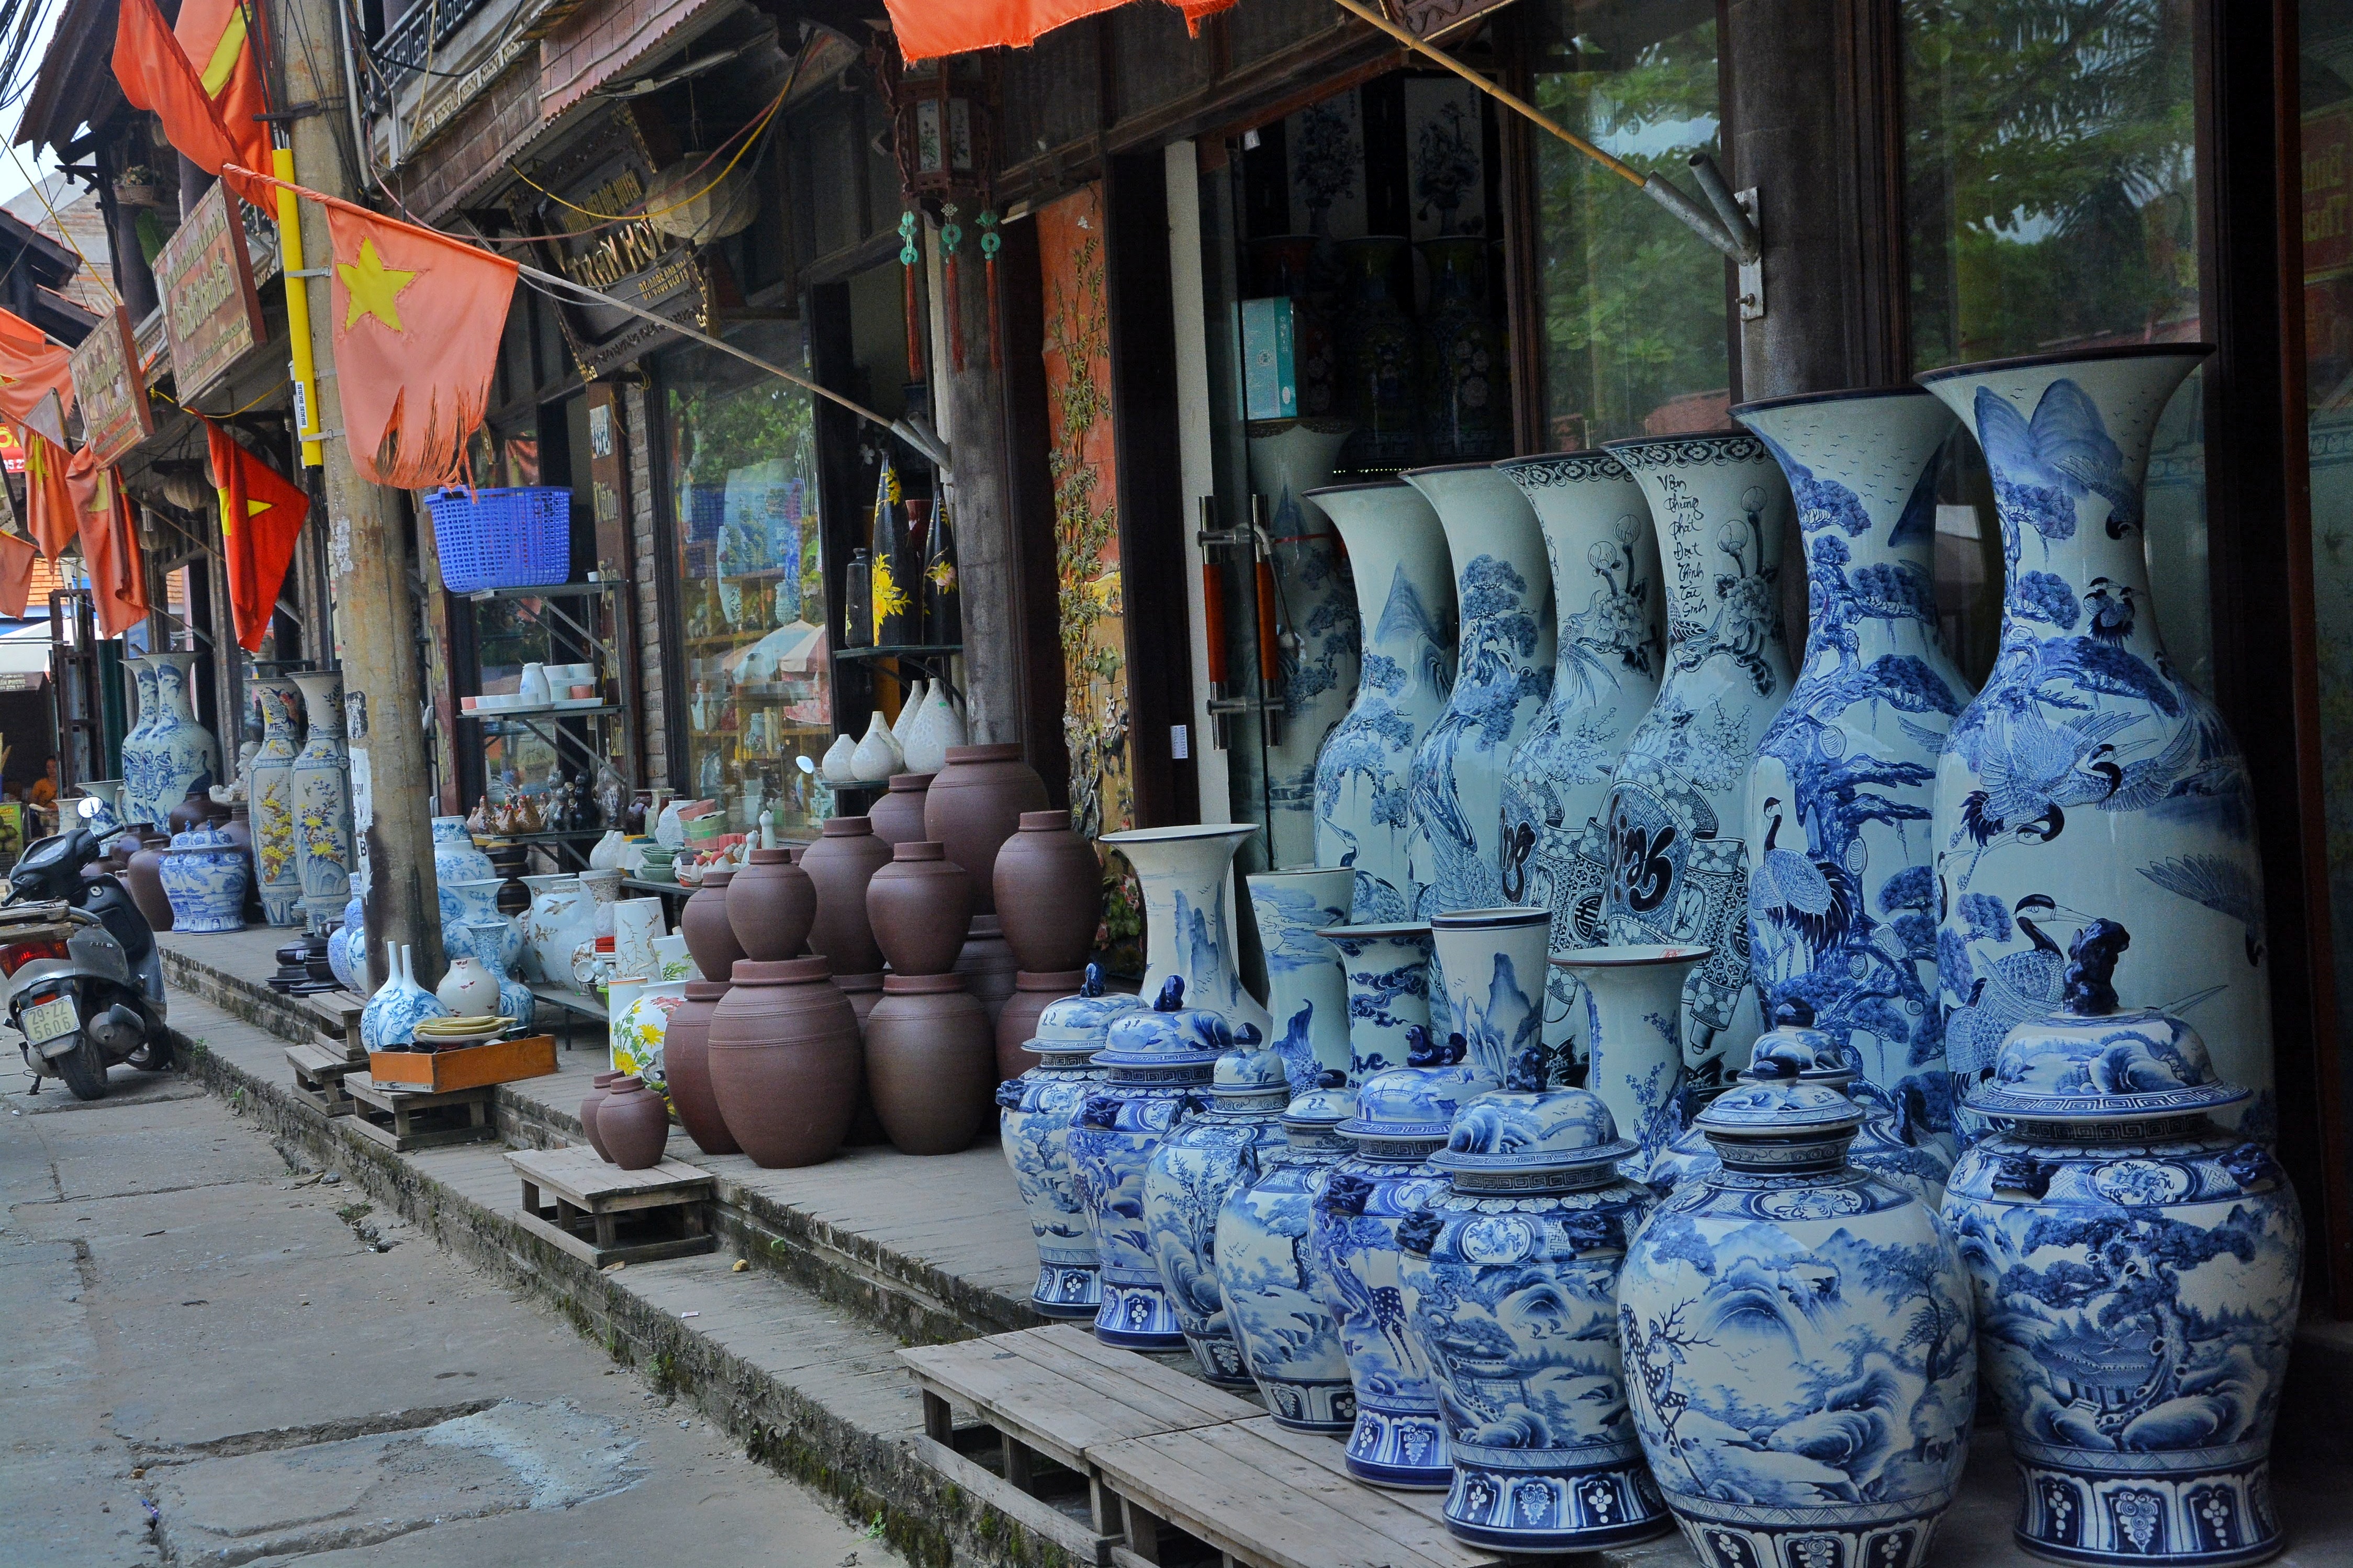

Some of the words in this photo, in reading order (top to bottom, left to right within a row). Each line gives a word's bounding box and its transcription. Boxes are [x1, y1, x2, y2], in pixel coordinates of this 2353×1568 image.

[1656, 474, 1686, 492] Vận
[1674, 541, 1703, 561] Đạt
[33, 1016, 71, 1040] 5606
